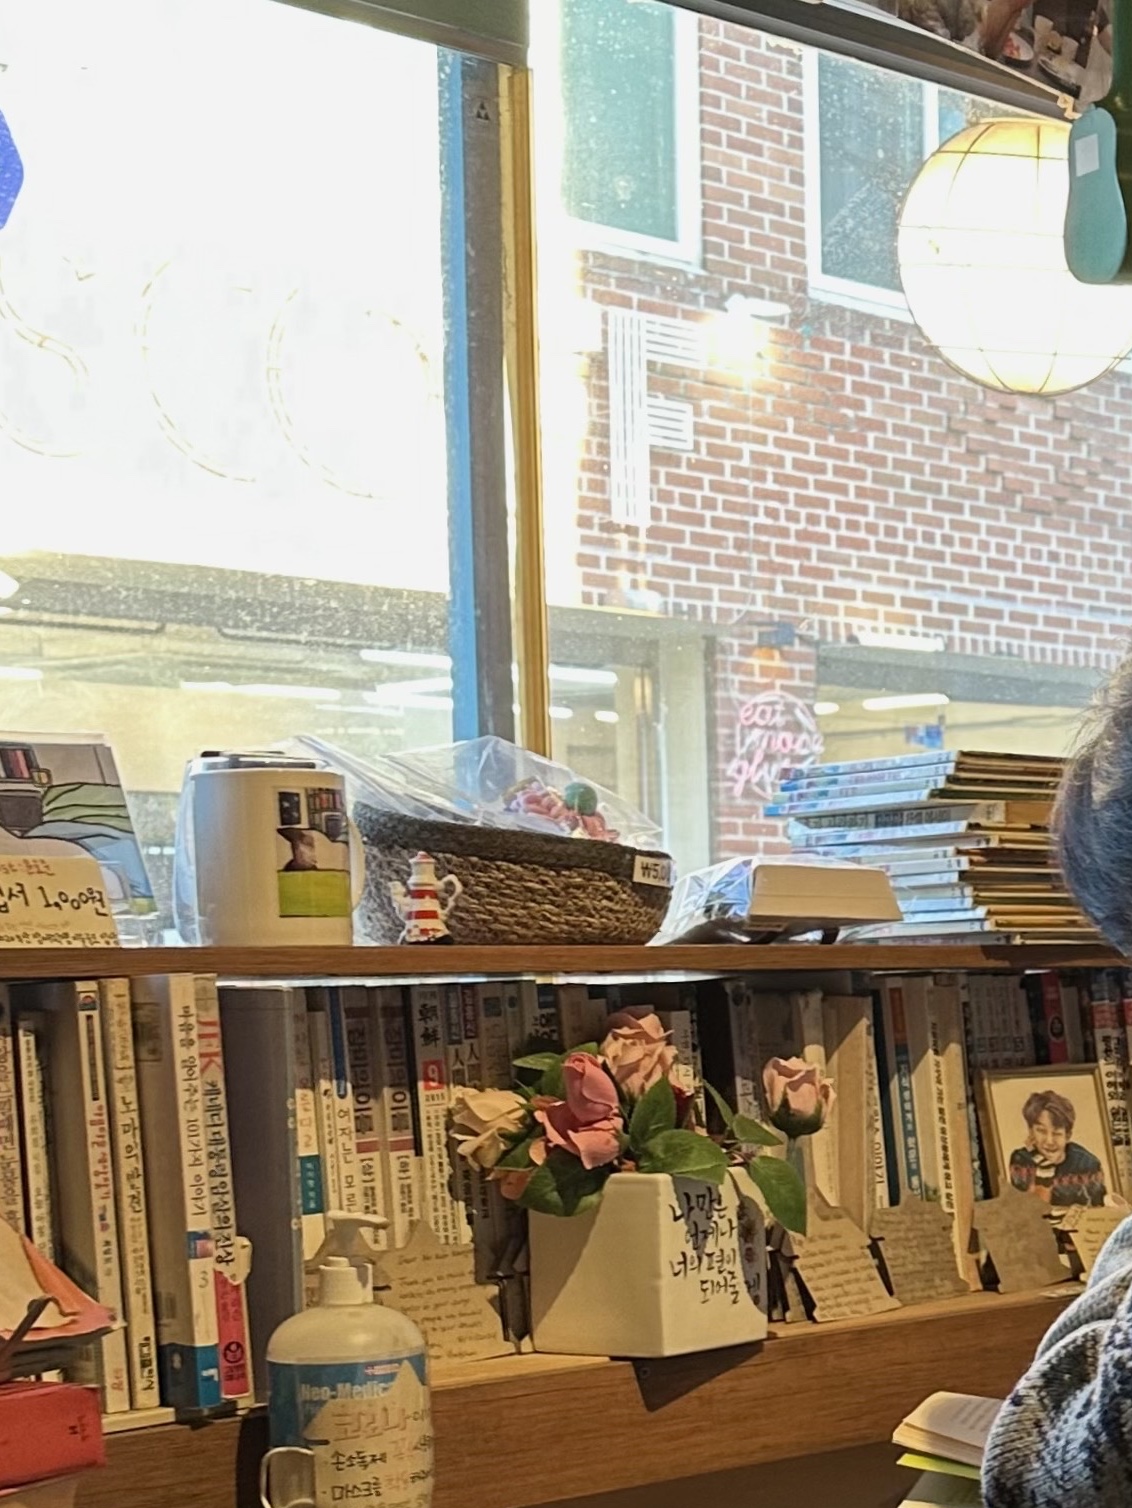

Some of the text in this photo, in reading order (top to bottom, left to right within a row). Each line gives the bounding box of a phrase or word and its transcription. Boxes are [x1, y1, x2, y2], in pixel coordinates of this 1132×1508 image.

[37, 886, 108, 917] 1,000원
[199, 1018, 223, 1076] JFK
[184, 1117, 204, 1168] 101가지
[189, 1173, 208, 1217] 이야기
[685, 1218, 738, 1251] 언제나
[668, 1251, 702, 1280] 너의
